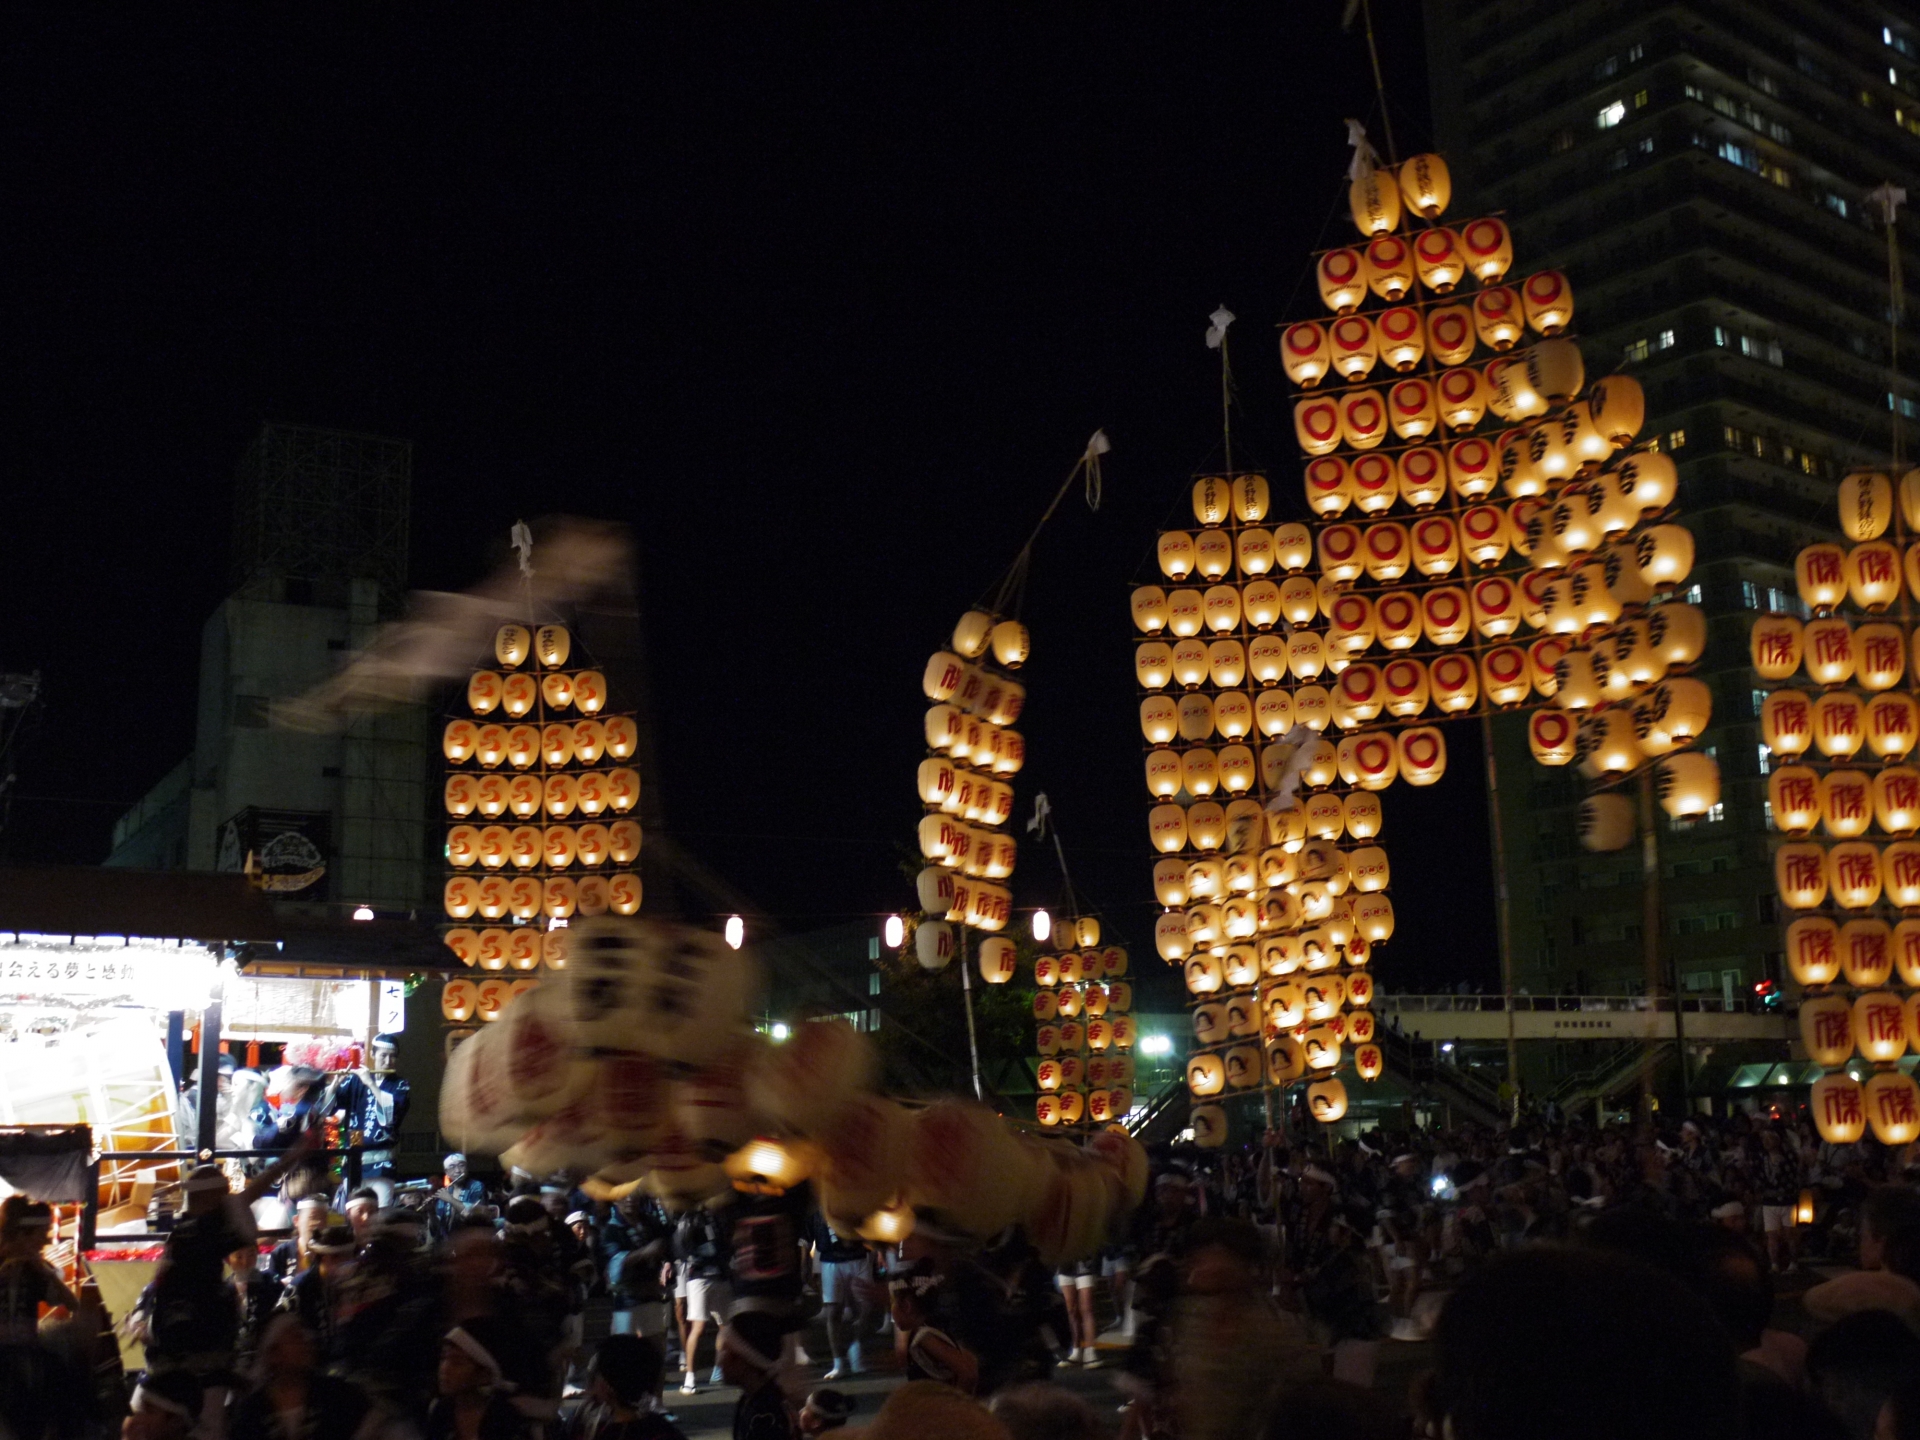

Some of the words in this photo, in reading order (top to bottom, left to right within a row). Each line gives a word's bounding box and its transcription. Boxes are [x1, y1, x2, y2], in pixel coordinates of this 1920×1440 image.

[0, 961, 135, 980] 会える夢と感動
